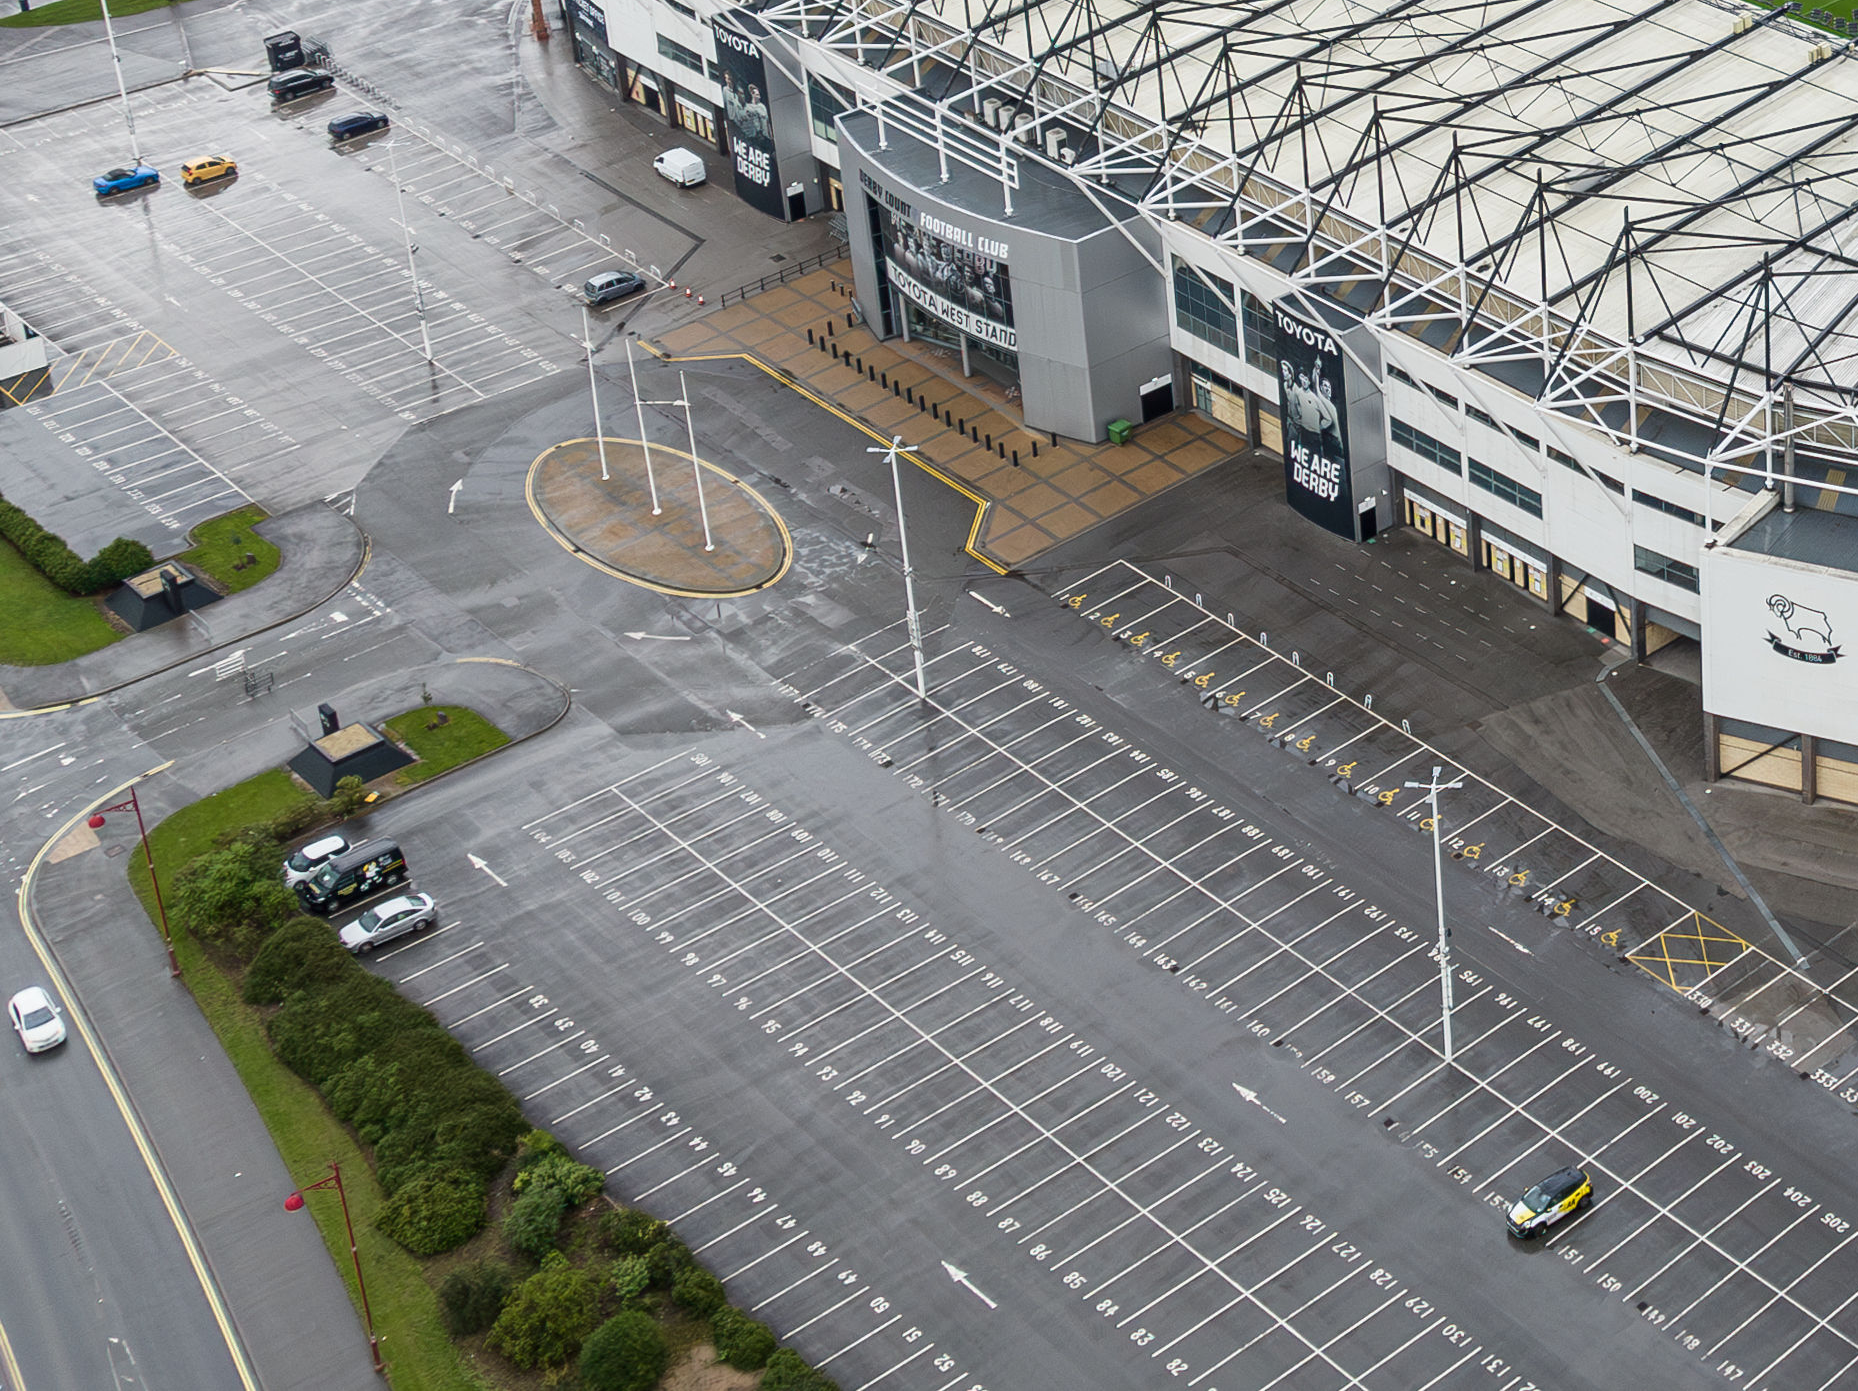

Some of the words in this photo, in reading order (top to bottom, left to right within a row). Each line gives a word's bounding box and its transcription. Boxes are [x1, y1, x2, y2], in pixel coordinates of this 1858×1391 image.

[713, 24, 759, 59] TOYOTA
[733, 137, 747, 159] WE
[748, 148, 770, 171] ARE
[737, 157, 770, 187] DERBY
[859, 168, 883, 199] DERBY
[885, 191, 919, 222] COUNT
[920, 212, 974, 248] FOOTBALL
[978, 236, 1009, 259] CLUB
[892, 265, 938, 311] TOYOTA
[941, 303, 971, 328] WEST
[975, 319, 1017, 347] STAND
[1275, 310, 1338, 356] TOYOTA
[1290, 440, 1309, 468] WE
[1310, 454, 1341, 484] ARE
[1293, 462, 1339, 502] DERBY
[972, 645, 991, 657] 178
[1788, 649, 1802, 660] Est.
[1023, 680, 1043, 692] 180
[1076, 714, 1096, 727] 182
[1102, 732, 1124, 746] 183
[1284, 733, 1296, 742] 8
[691, 754, 712, 766] 105
[1156, 769, 1179, 783] 185
[1364, 784, 1379, 795] 10
[766, 810, 787, 823] 108
[1242, 825, 1265, 840] 188
[1449, 838, 1465, 850] 12
[580, 870, 599, 883] 102
[1302, 865, 1324, 879] 190
[628, 909, 651, 925] 100
[1364, 906, 1387, 922] 192
[1124, 932, 1146, 948] 164
[1394, 927, 1419, 942] 193
[681, 953, 699, 966] 98
[950, 950, 975, 966] 115
[1154, 953, 1177, 969] 163
[707, 974, 727, 987] 97
[529, 995, 548, 1008] 38
[1495, 993, 1518, 1009] 196
[761, 1020, 781, 1033] 95
[1040, 1017, 1064, 1033] 118
[1247, 1020, 1270, 1037] 160
[580, 1040, 599, 1053] 40
[1562, 1038, 1586, 1055] 198
[1766, 1040, 1793, 1060] 332
[1101, 1063, 1126, 1082] 120
[634, 1087, 653, 1101] 42
[846, 1091, 866, 1105] 92
[1134, 1088, 1159, 1107] 121
[1345, 1091, 1371, 1108] 157
[1634, 1086, 1659, 1104] 200
[661, 1112, 680, 1126] 43
[1166, 1112, 1191, 1131] 122
[1672, 1112, 1696, 1129] 201
[1198, 1138, 1224, 1156] 123
[1706, 1134, 1734, 1154] 202
[717, 1162, 737, 1176] 45
[935, 1164, 957, 1180] 89
[1231, 1162, 1258, 1182] 124
[1744, 1161, 1772, 1179] 203
[966, 1191, 988, 1206] 88
[1264, 1188, 1292, 1208] 125
[1783, 1187, 1812, 1207] 204
[998, 1218, 1021, 1233] 87
[1300, 1215, 1326, 1235] 126
[1820, 1213, 1850, 1233] 205
[807, 1241, 827, 1256] 48
[1030, 1244, 1052, 1260] 86
[1332, 1242, 1362, 1262] 127
[1558, 1245, 1584, 1265] 151
[1063, 1272, 1087, 1289] 85
[1369, 1269, 1398, 1290] 128
[1597, 1273, 1622, 1292] 150
[870, 1297, 890, 1313] 50
[1096, 1299, 1119, 1317] 84
[1405, 1297, 1434, 1318] 129
[902, 1327, 922, 1342] 51
[1130, 1328, 1155, 1346] 83
[934, 1353, 955, 1372] 52
[1166, 1359, 1188, 1376] 82
[1481, 1354, 1511, 1377] 131
